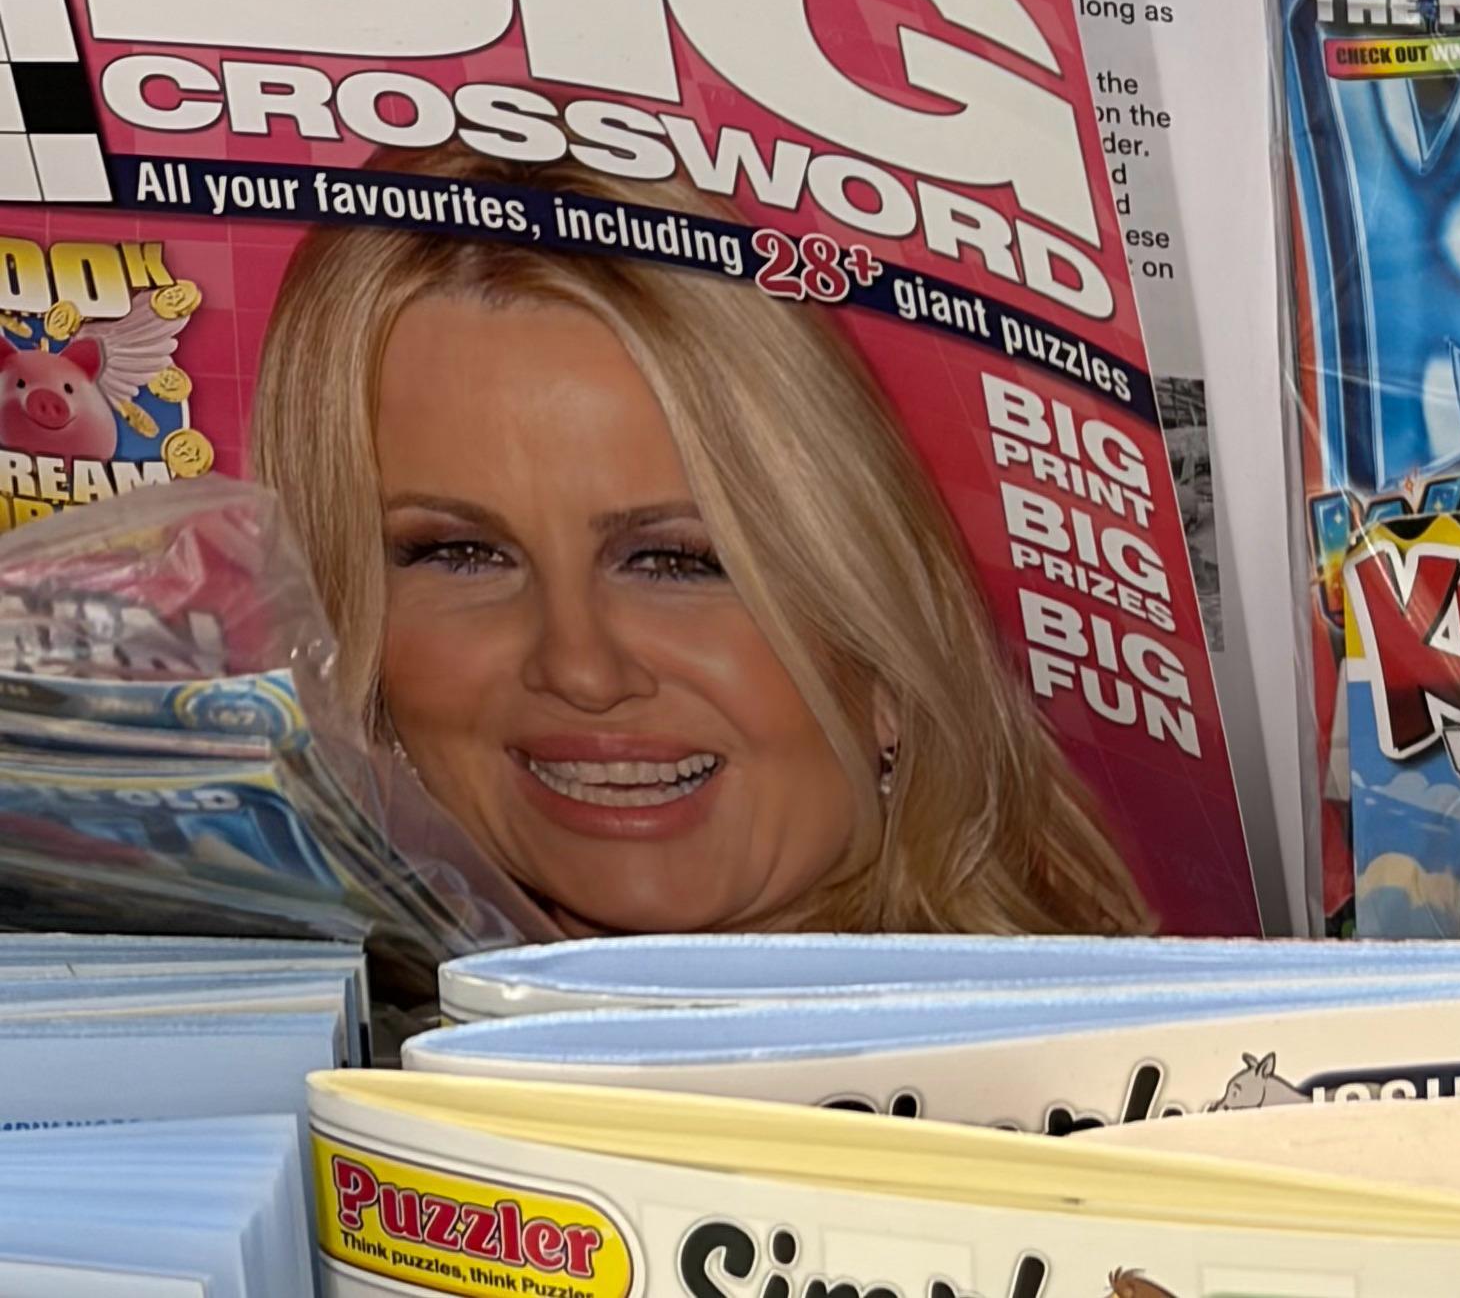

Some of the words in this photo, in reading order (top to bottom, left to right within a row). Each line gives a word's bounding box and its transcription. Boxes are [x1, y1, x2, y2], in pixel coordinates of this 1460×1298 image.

[1145, 2, 1174, 24] as
[1335, 45, 1392, 66] CHECK
[1395, 44, 1428, 64] OUT
[1096, 72, 1139, 96] the
[1129, 106, 1172, 129] the
[100, 53, 1117, 320] CROSSWORD
[136, 159, 191, 205] All
[204, 167, 300, 215] your
[313, 172, 542, 239] favourites,
[554, 196, 744, 277] including
[750, 228, 884, 303] 28+
[892, 273, 992, 340] giant
[1000, 310, 1133, 402] puzzles
[980, 370, 1152, 498] BIG
[991, 431, 1156, 530] PRINT
[1000, 481, 1171, 600] BIG
[1010, 541, 1177, 633] PRIZES
[1017, 587, 1193, 705] BIG
[1027, 647, 1203, 760] FUN
[331, 1154, 605, 1281] Puzzler
[339, 1230, 389, 1262] Think
[470, 1264, 518, 1293] think
